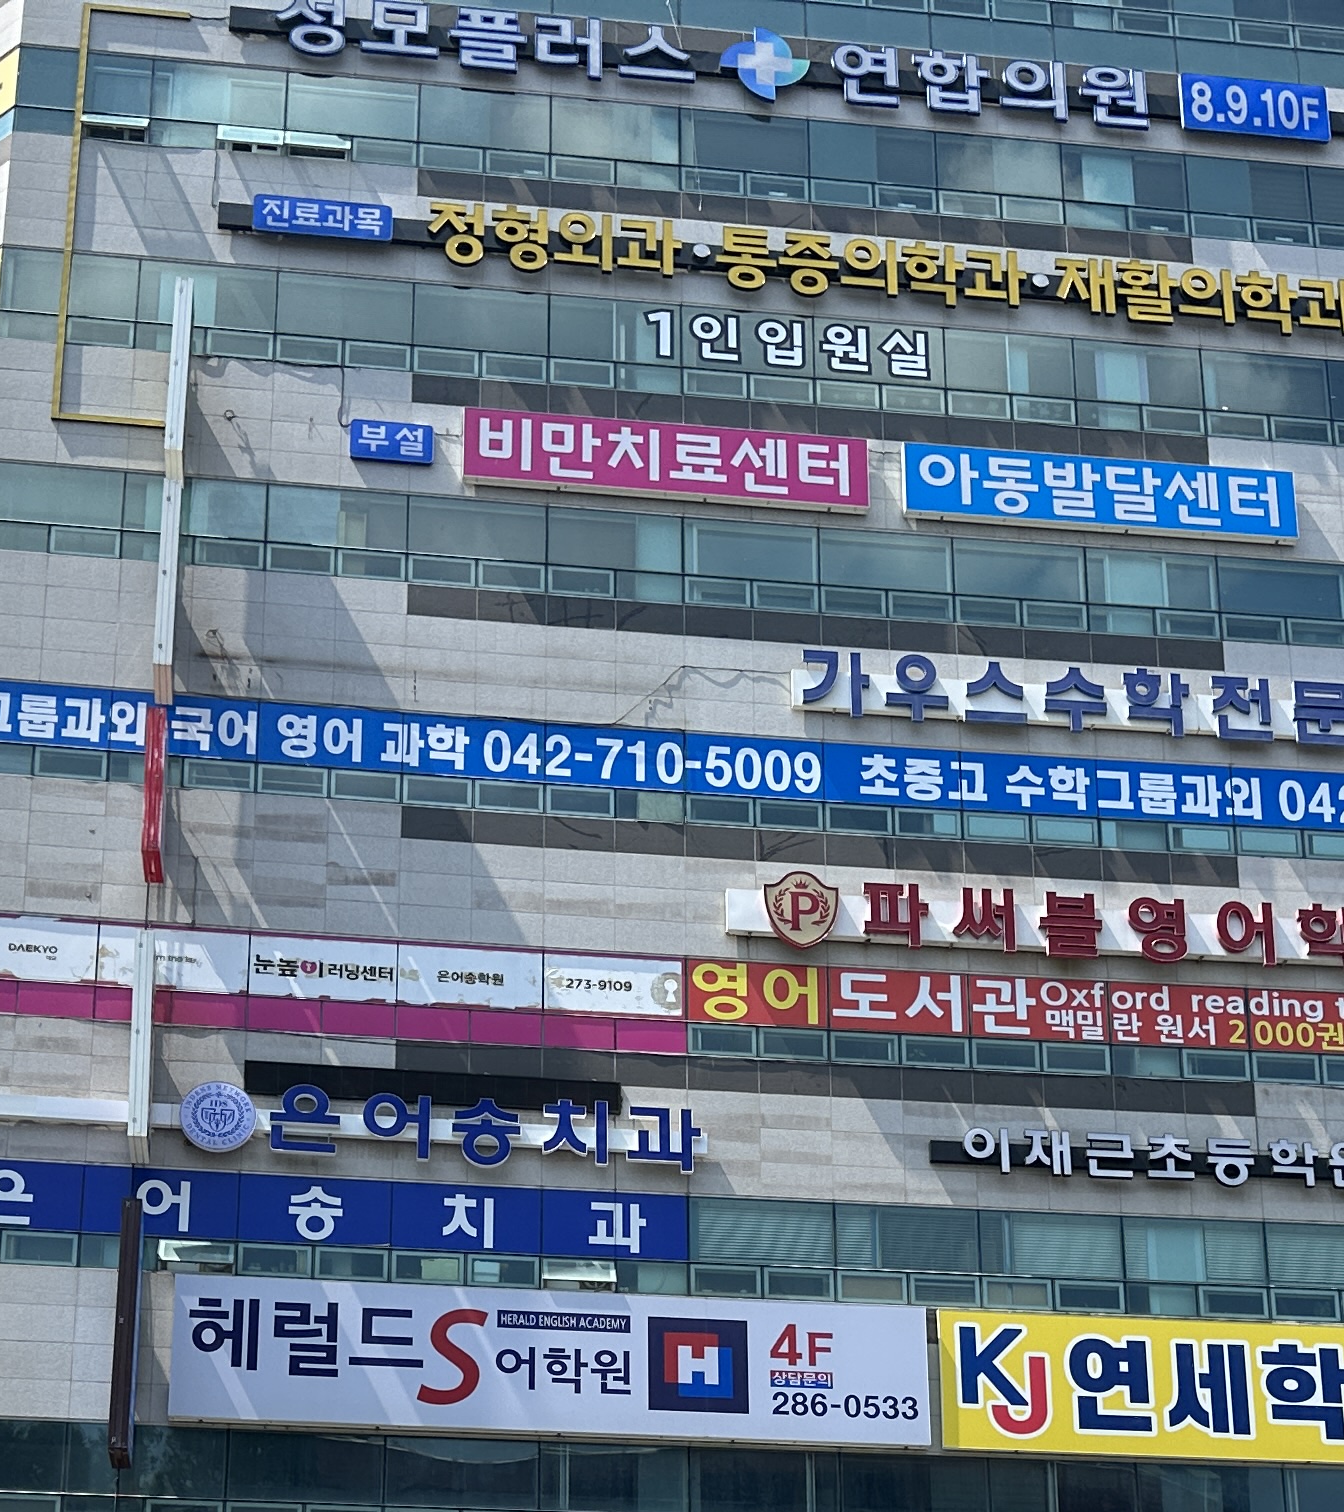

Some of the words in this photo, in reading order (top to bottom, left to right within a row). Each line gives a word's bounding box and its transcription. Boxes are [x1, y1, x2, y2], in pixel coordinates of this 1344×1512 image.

[275, 0, 696, 83] 성모플러스
[831, 43, 1150, 130] 연합의원
[1190, 79, 1319, 132] 8.9.10F
[261, 199, 384, 237] 진료과목
[357, 424, 425, 459] 부설
[478, 417, 850, 496] 비만치료센터
[918, 451, 1281, 529] 아동발달센터
[170, 706, 257, 756] 국어
[276, 713, 362, 763] 영어
[380, 721, 470, 771] 과학
[483, 729, 822, 795] 042-710-5009
[859, 754, 988, 803] 초중고
[1006, 766, 1264, 821] 수학그룹과외
[8, 942, 58, 955] DAEKYO
[327, 964, 395, 983] 러닝센터
[437, 970, 505, 987] 은어송학원
[566, 976, 633, 992] 273-9109
[1040, 981, 1170, 1013] Oxford
[1192, 988, 1323, 1022] reading
[1044, 1008, 1142, 1042] 맥밀란
[1154, 1014, 1216, 1046] 원서
[1229, 1019, 1344, 1051] 2000권
[269, 1083, 702, 1174] 은어송치과
[500, 1312, 538, 1329] HERALD
[539, 1313, 577, 1330] ENGLISH
[579, 1315, 627, 1332] ACADEMY
[189, 1296, 424, 1378] 헤럴드
[495, 1346, 631, 1396] 어학원
[769, 1324, 834, 1367] 4F
[771, 1371, 833, 1388] 상담문의
[958, 1324, 1048, 1435] KJ
[771, 1392, 920, 1421] 286-0533
